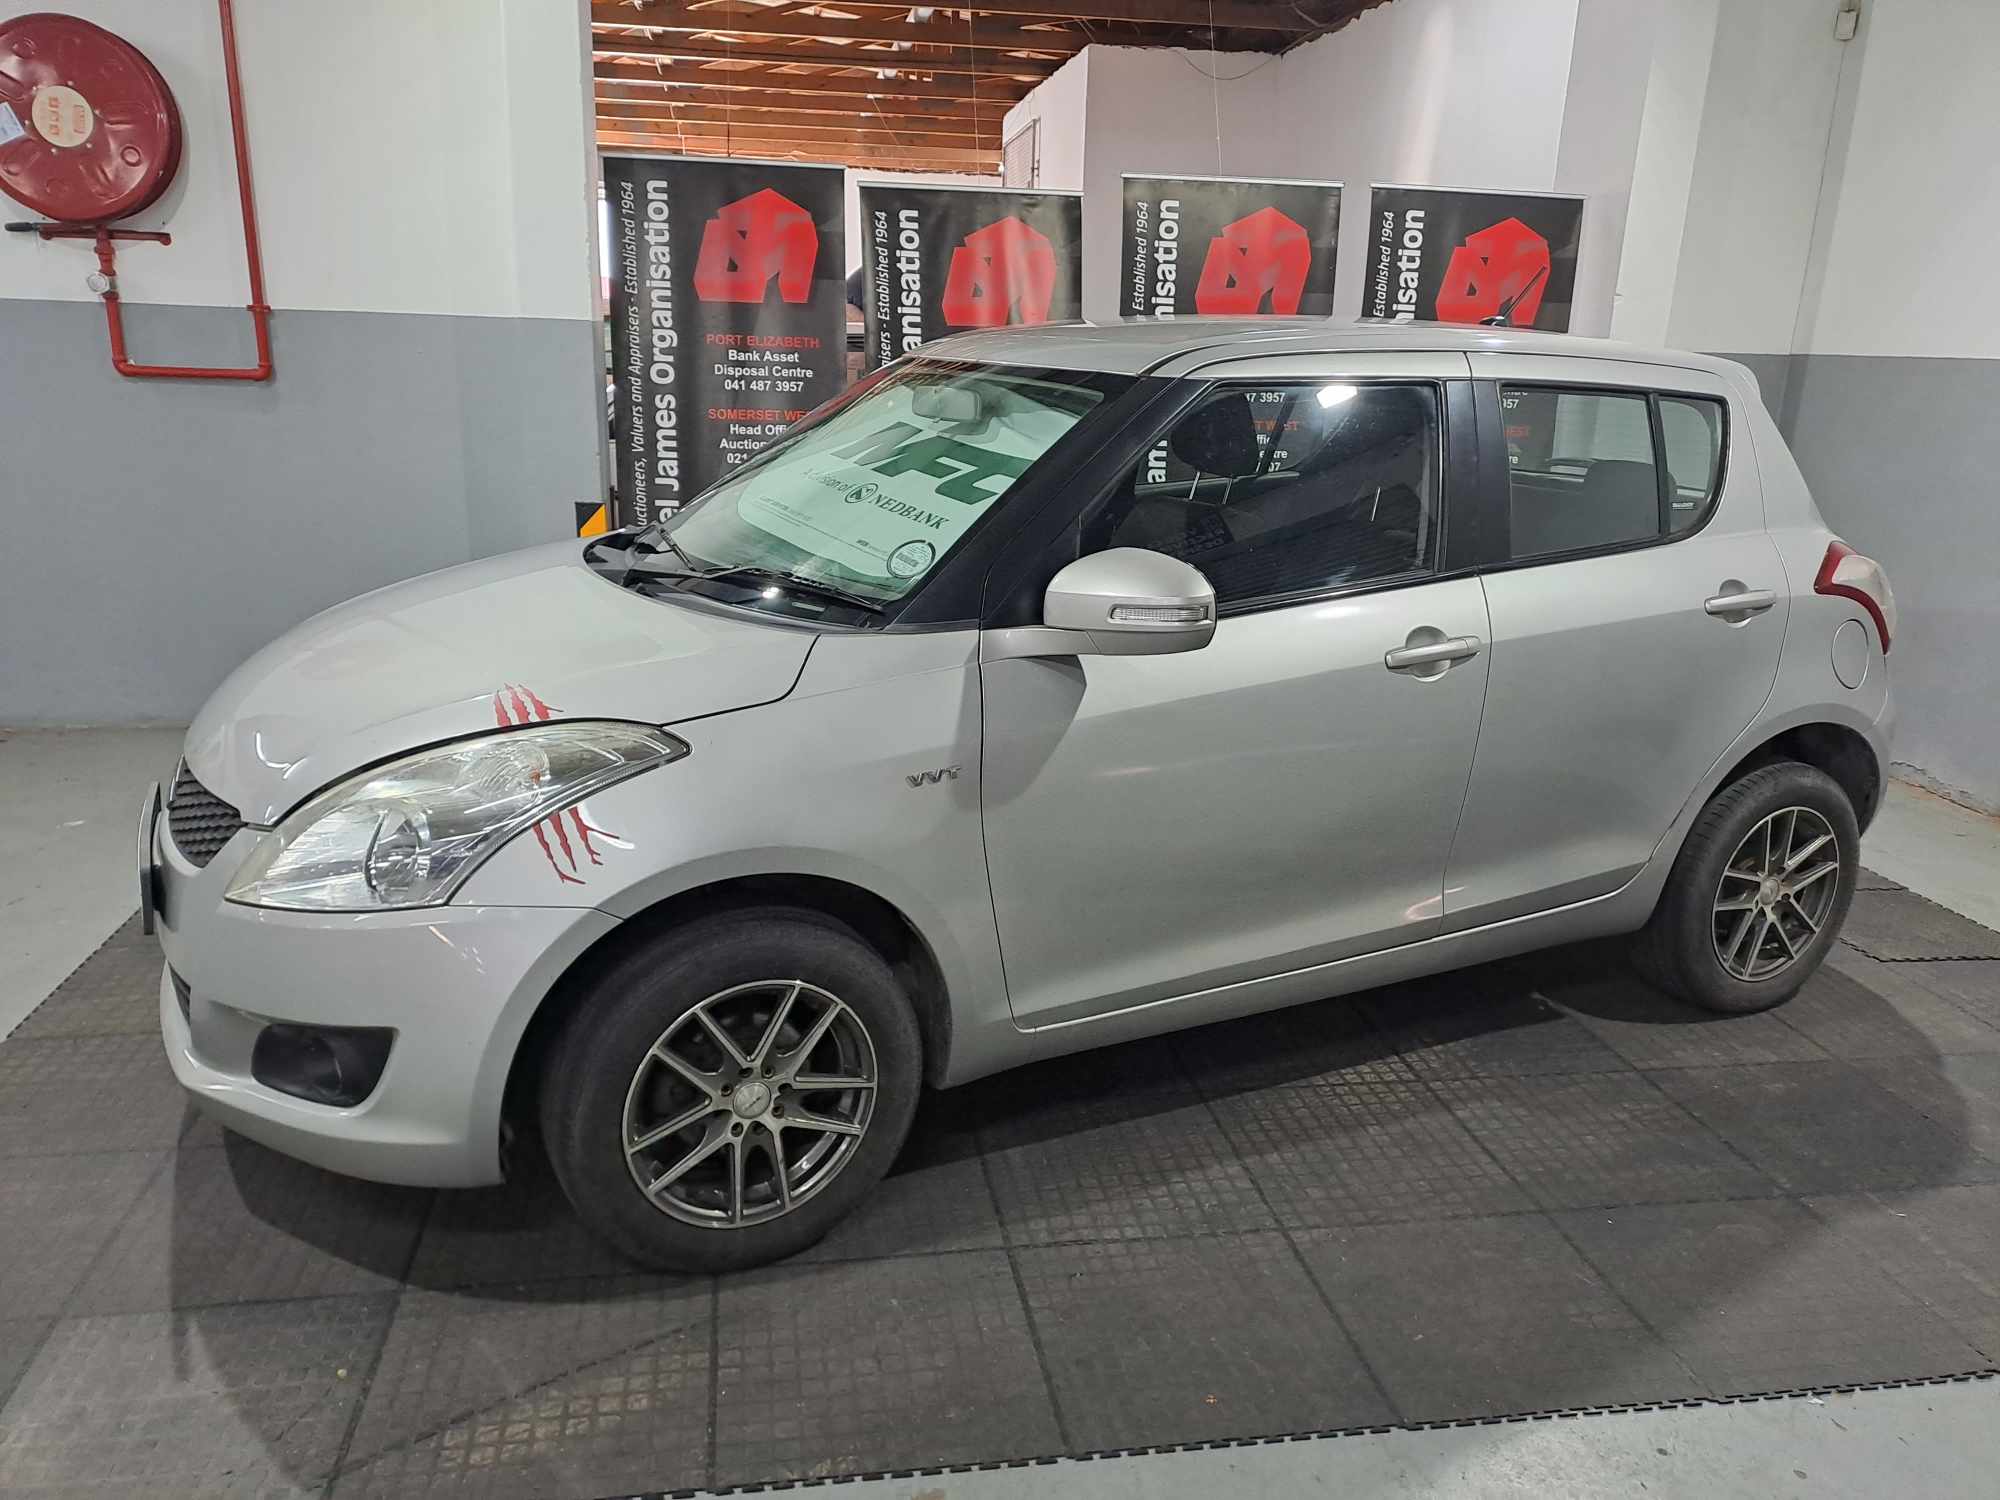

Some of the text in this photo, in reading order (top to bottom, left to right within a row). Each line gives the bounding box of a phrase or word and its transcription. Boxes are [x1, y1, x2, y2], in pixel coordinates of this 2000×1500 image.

[620, 181, 635, 214] 1964
[875, 211, 888, 242] 1964
[622, 218, 638, 294] Established
[1132, 201, 1149, 311] Established 1964
[1373, 211, 1394, 317] Established 1964
[643, 180, 678, 384] Organisation
[875, 246, 890, 320] Established
[626, 305, 644, 374] Appraisers
[705, 334, 820, 348] PORT ELIZABETH
[728, 349, 800, 362] Bank Asset
[714, 364, 814, 378] Disposal Centre
[724, 379, 804, 392] 041 487 3957
[628, 376, 642, 402] and
[1260, 392, 1286, 403] 3957
[630, 405, 645, 452] Valuers
[708, 408, 780, 421] SOMERSET
[729, 423, 762, 435] Head
[654, 394, 679, 491] James
[633, 457, 648, 526] uctioneers,
[868, 493, 950, 530] NEDBANK
